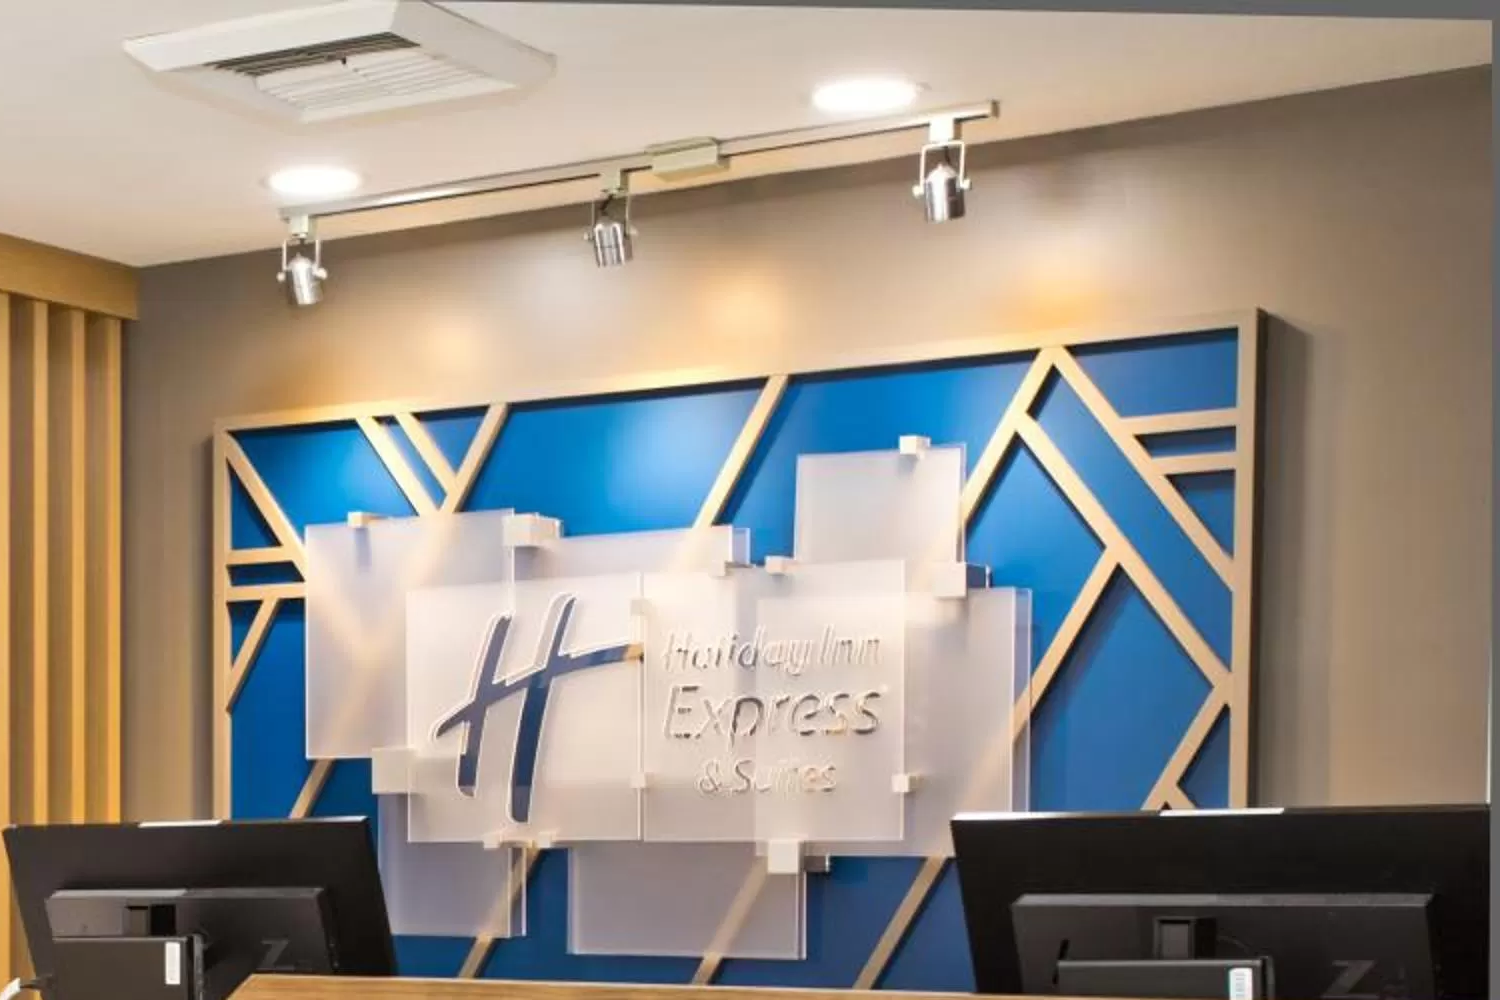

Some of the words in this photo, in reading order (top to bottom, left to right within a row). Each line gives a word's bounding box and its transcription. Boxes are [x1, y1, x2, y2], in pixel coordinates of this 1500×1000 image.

[662, 624, 813, 677] Holiday
[818, 624, 883, 666] Inn
[664, 684, 881, 753] Express
[696, 759, 723, 794] &
[731, 759, 837, 794] Suites
